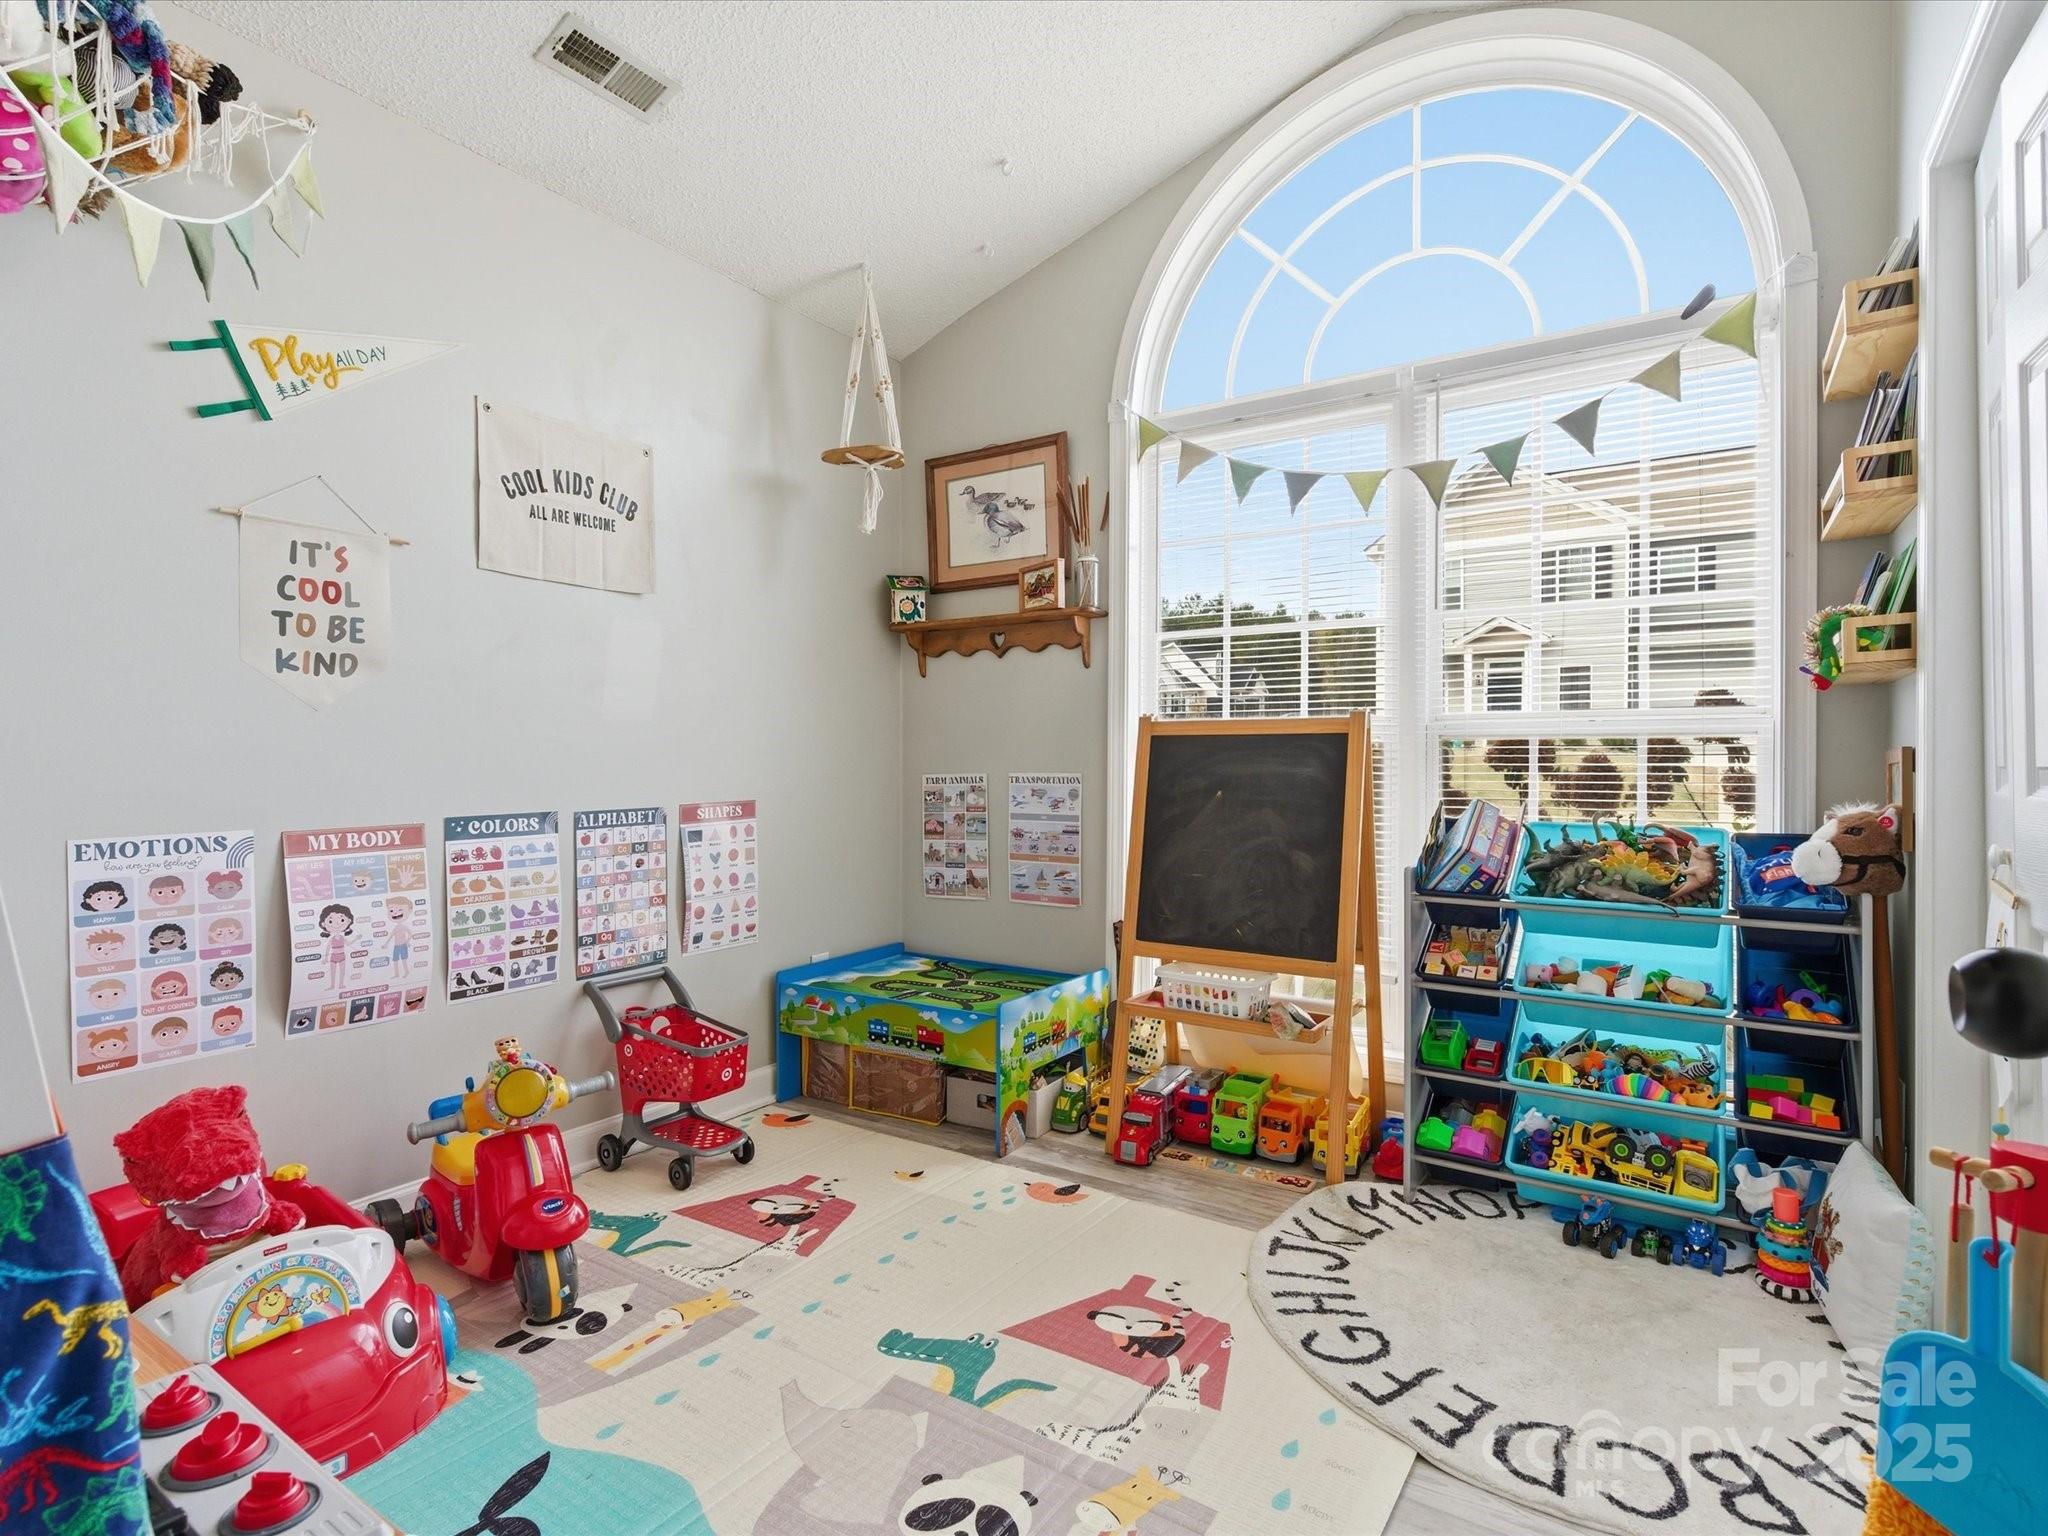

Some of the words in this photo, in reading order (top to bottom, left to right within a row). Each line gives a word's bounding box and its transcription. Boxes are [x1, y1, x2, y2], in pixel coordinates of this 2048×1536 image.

[248, 335, 364, 390] Play
[356, 346, 387, 365] DAY
[500, 468, 550, 500] COOL
[553, 468, 596, 499] KIDS
[599, 482, 639, 522] CLUB
[529, 504, 548, 520] ALL
[551, 508, 571, 525] ARE
[573, 513, 617, 533] WELCOME
[289, 540, 350, 574] IT'S
[277, 575, 361, 608] COOL
[271, 610, 317, 638] TO
[327, 615, 366, 645] BE
[275, 648, 359, 678] KIND
[925, 777, 947, 785] FARM
[948, 776, 984, 785] ANIMALS
[1009, 775, 1081, 785] TRANSPORTATION
[578, 810, 656, 828] ALPHABET
[696, 805, 743, 820] SHAPES
[468, 817, 540, 834] COLORS
[74, 835, 228, 863] EMOTIONS
[307, 834, 343, 852] MY
[346, 830, 404, 849] BODY
[104, 860, 124, 871] how
[93, 915, 117, 924] HAPPY
[466, 987, 490, 997] BLACK
[101, 1014, 115, 1022] SAD
[96, 1061, 120, 1071] ANGRY
